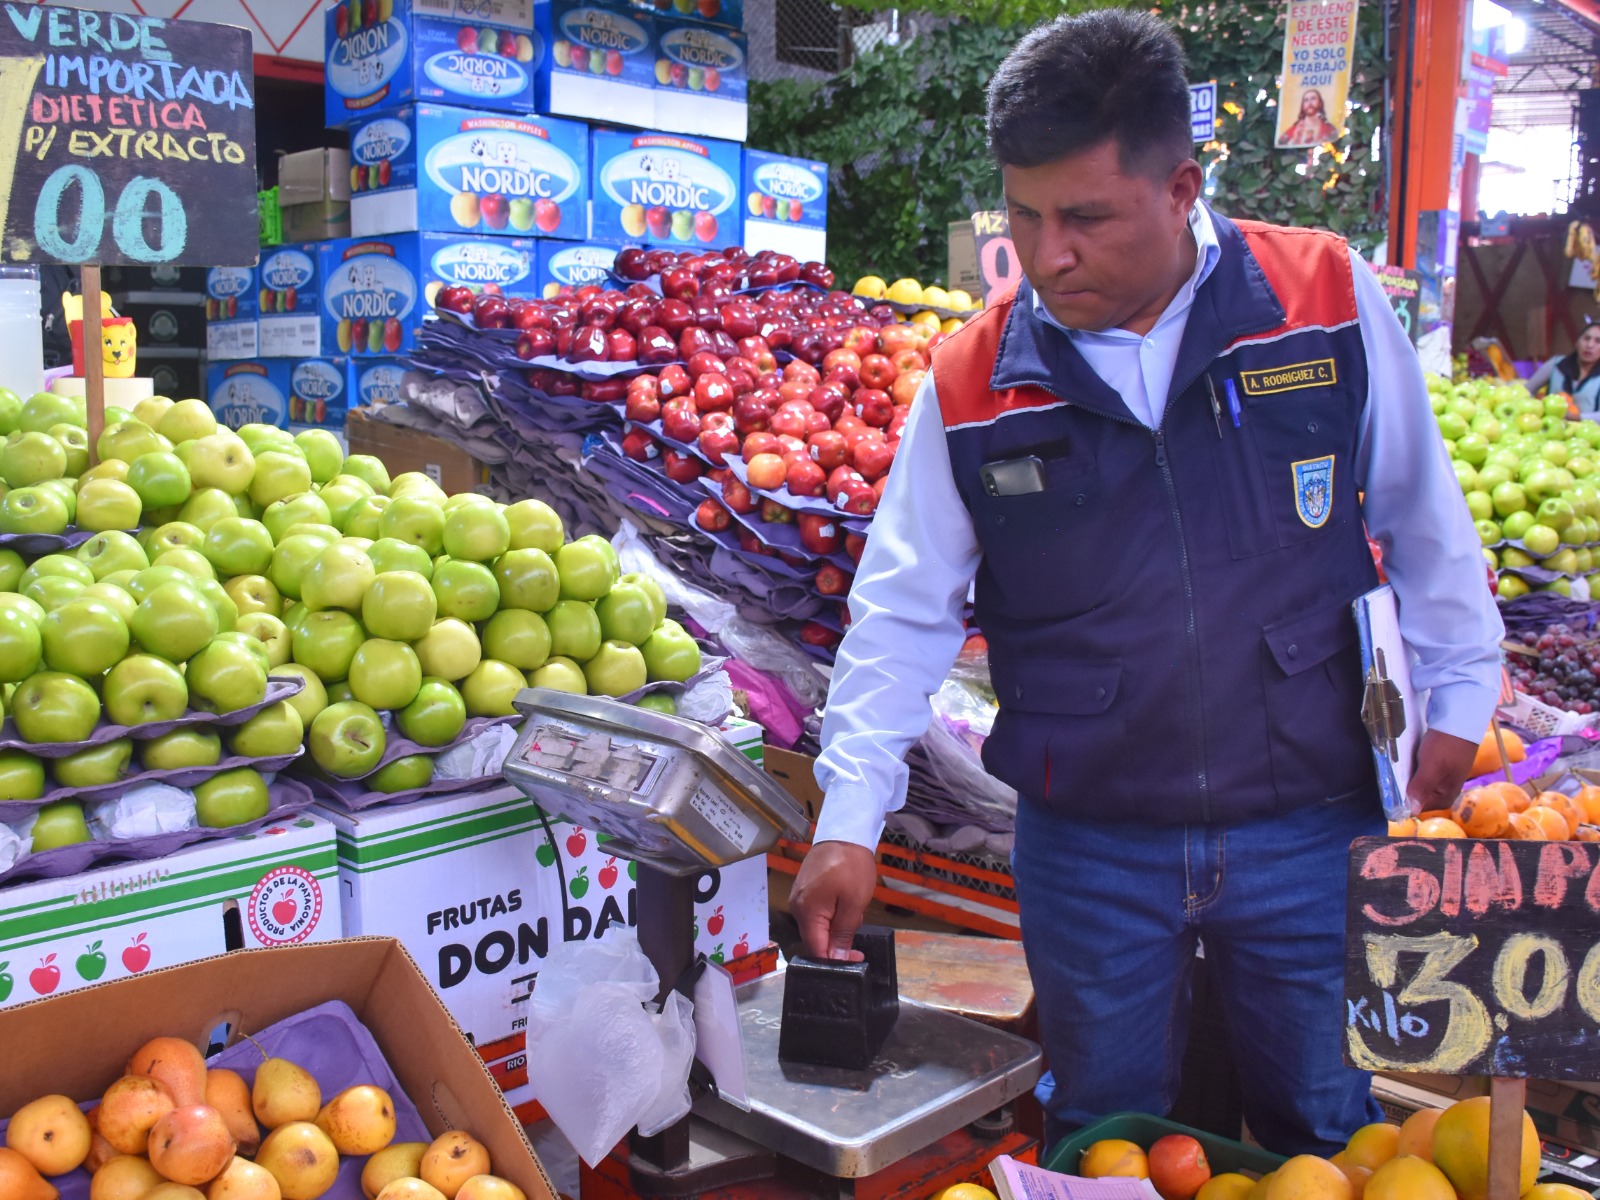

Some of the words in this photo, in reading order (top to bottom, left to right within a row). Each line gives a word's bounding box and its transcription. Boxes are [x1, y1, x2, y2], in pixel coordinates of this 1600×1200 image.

[1292, 6, 1306, 18] ES
[4, 3, 173, 61] VERDE
[1297, 20, 1313, 32] DE
[1317, 16, 1347, 30] ESTE
[341, 23, 388, 64] NORDIC
[580, 27, 631, 50] NORDIC
[1292, 31, 1349, 46] NEGOCIO
[679, 46, 727, 67] NORDIC
[1293, 49, 1309, 61] YO
[1313, 47, 1345, 60] SOLO
[449, 55, 507, 77] NORDIC
[1290, 60, 1346, 74] TRABAJO
[45, 54, 254, 110] IMPORTADA
[1301, 75, 1332, 86] AQUI
[466, 119, 516, 130] WASHINGTON
[518, 124, 542, 137] APPLES
[25, 125, 57, 161] P/
[68, 127, 245, 164] EXTRACTO
[363, 138, 396, 160] NORDIC
[637, 137, 681, 149] WASHINGTON
[461, 166, 551, 198] NORDIC
[769, 179, 811, 198] NORDIC
[631, 180, 709, 210] NORDIC
[271, 272, 302, 285] NORDIC
[454, 264, 510, 281] NORDIC
[214, 279, 241, 294] NORDIC
[343, 292, 396, 317] NORDIC
[1251, 378, 1260, 389] A.
[1263, 368, 1316, 388] RODRIGUEZ
[1318, 366, 1328, 378] C.
[301, 381, 332, 397] NORDIC
[224, 407, 268, 428] NORDIC
[273, 877, 285, 888] DE
[288, 877, 297, 886] LA
[259, 886, 285, 936] PRODUCTOS
[290, 882, 311, 931] PATAGONIA
[427, 888, 522, 936] FRUTAS
[438, 916, 549, 990] DON
